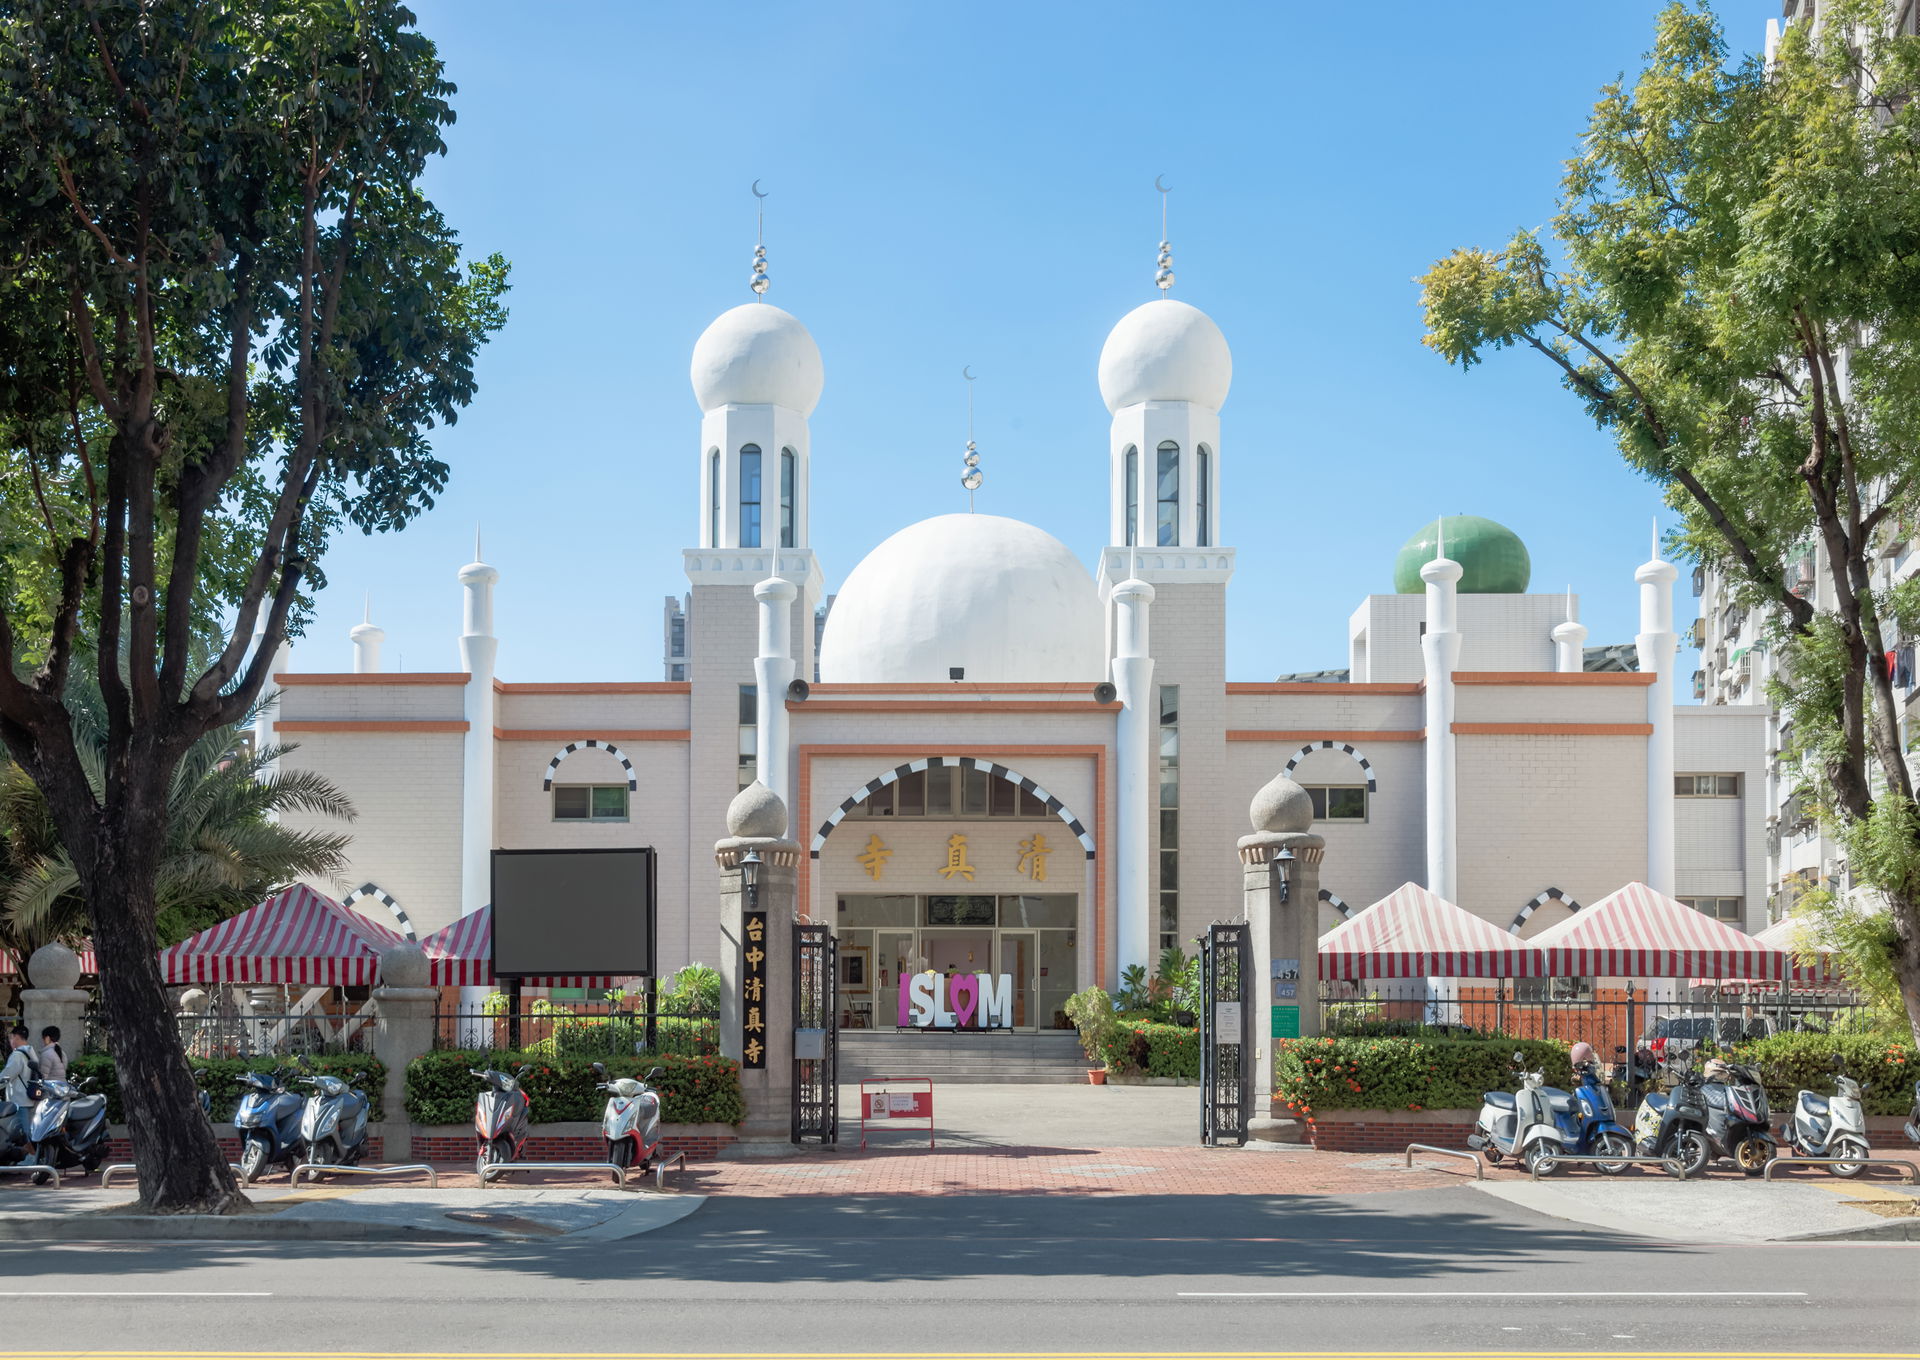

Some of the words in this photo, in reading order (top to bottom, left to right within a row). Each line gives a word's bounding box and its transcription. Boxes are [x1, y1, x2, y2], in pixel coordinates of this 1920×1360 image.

[856, 832, 1053, 882] 清真寺
[744, 917, 765, 1064] 台中清真寺
